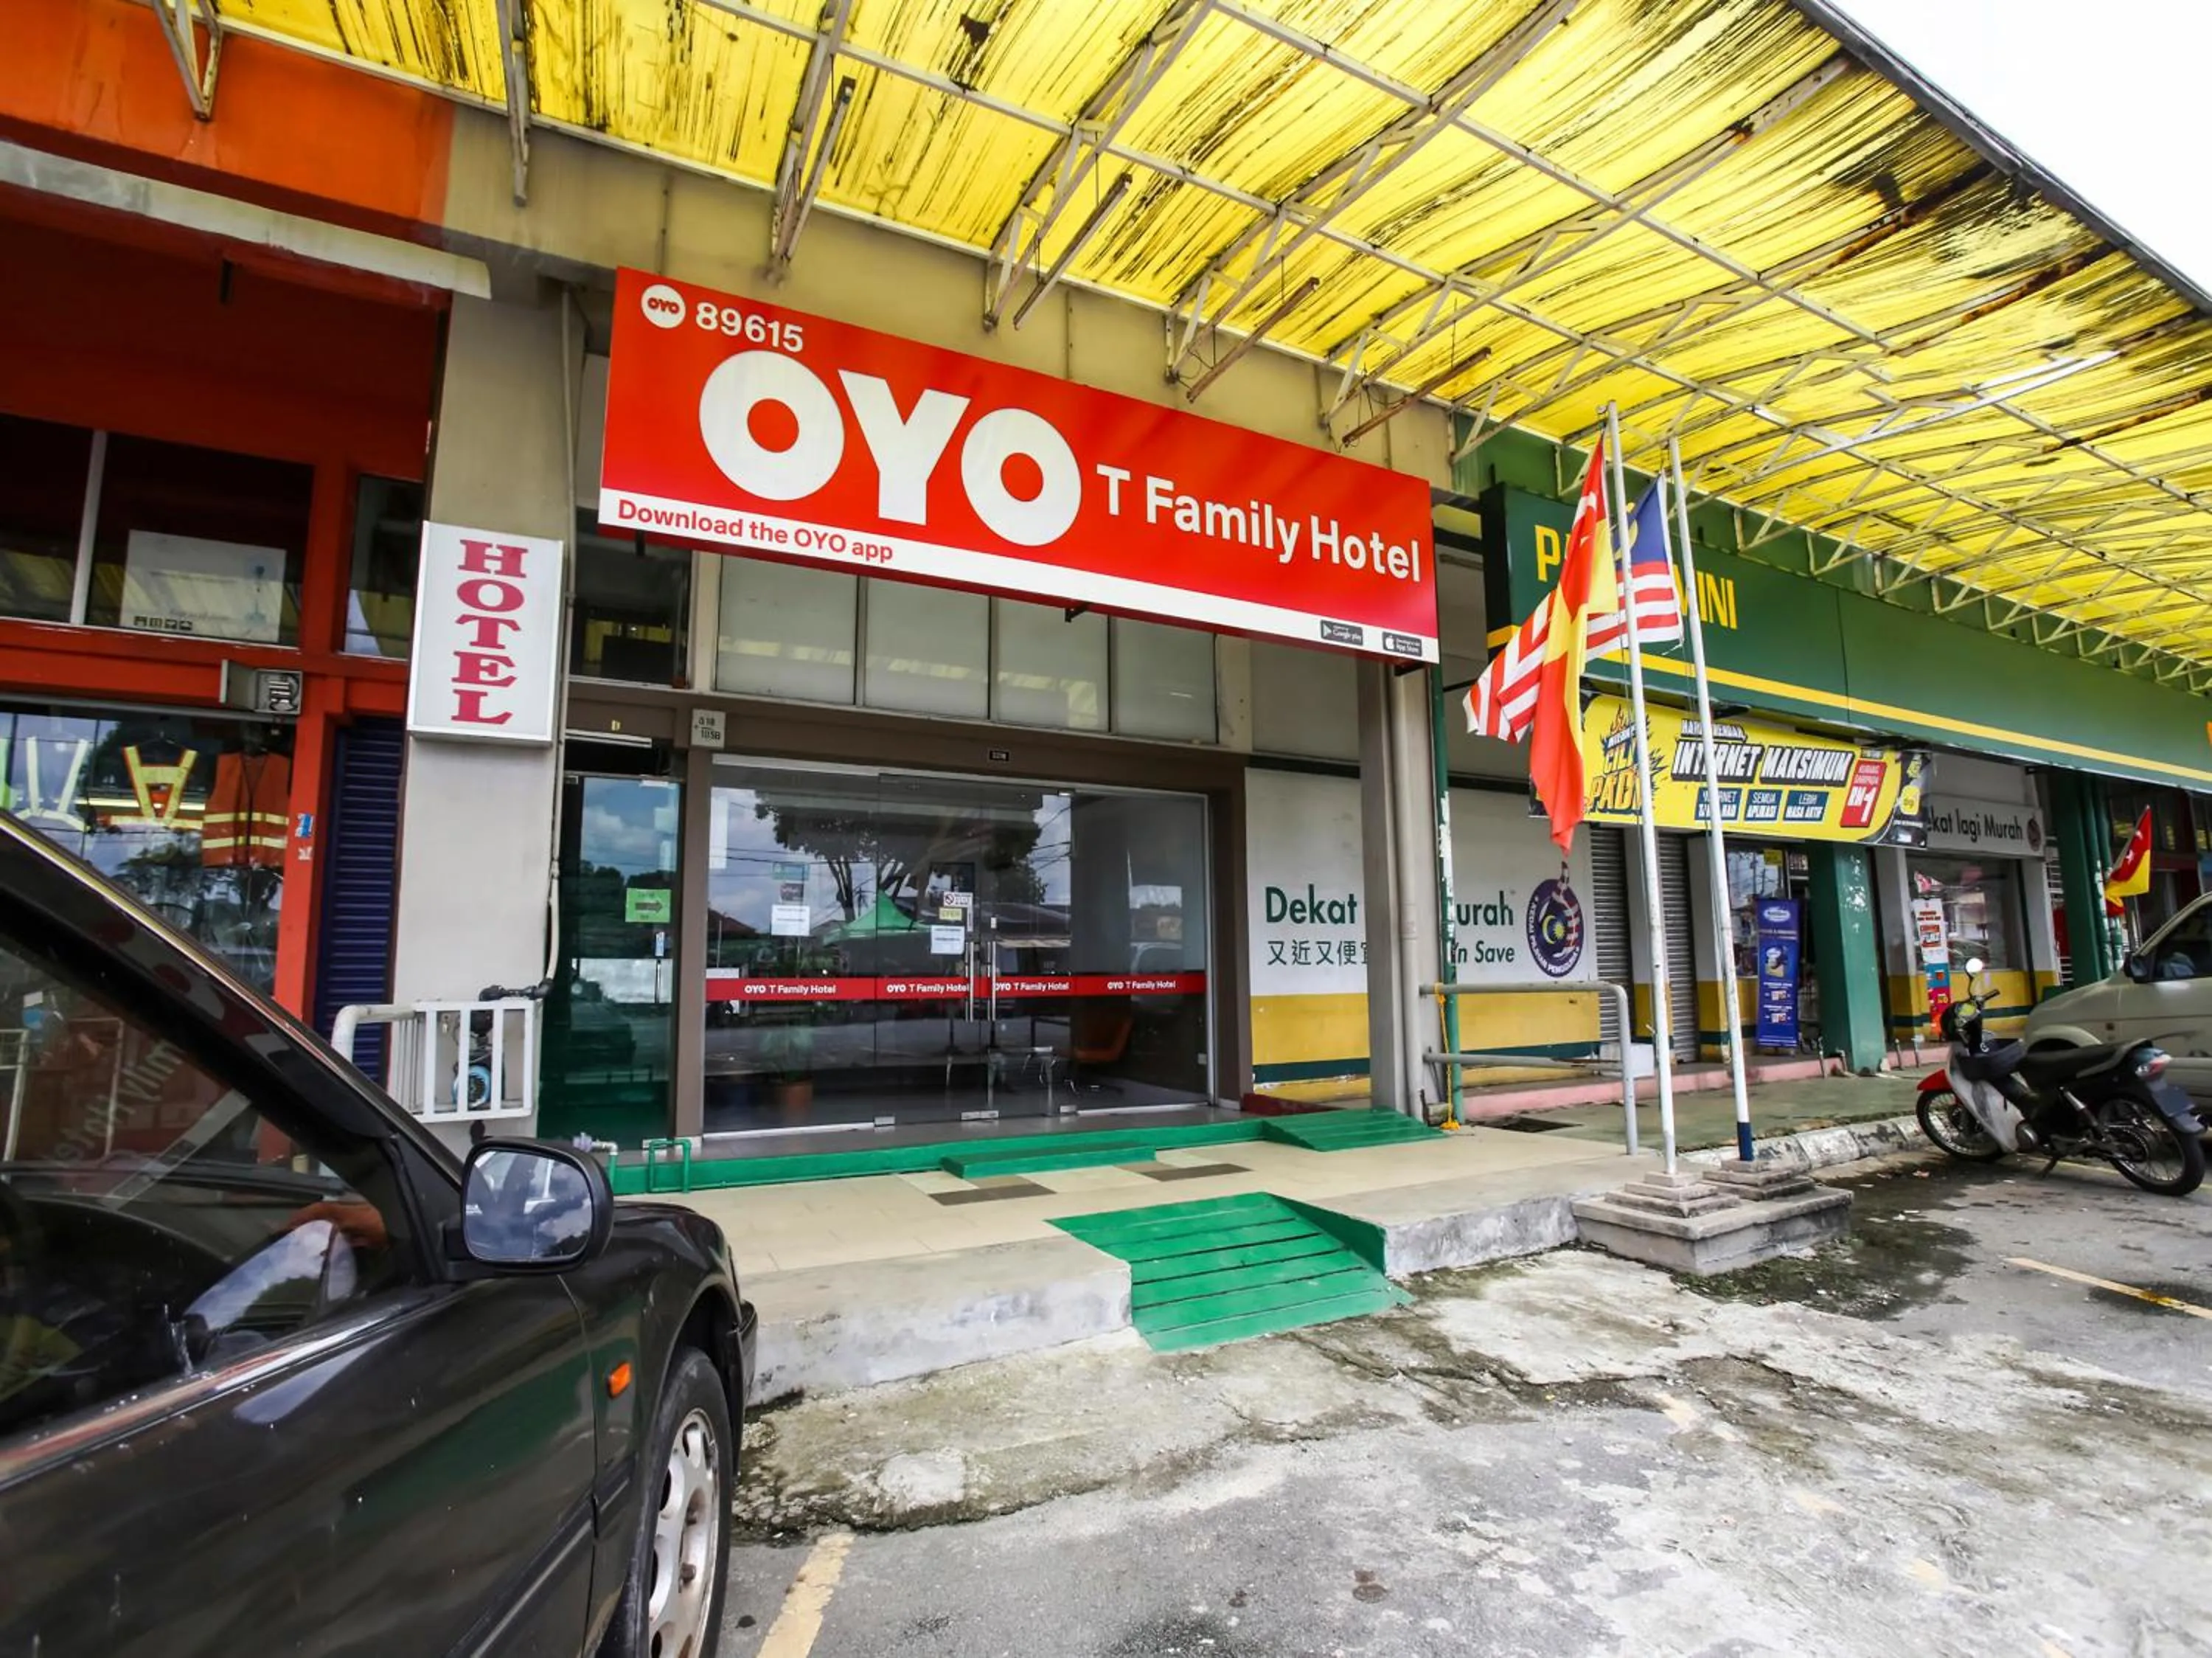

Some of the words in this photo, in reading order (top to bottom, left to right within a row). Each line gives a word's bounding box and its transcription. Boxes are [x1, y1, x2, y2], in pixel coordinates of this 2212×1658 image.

[696, 302, 803, 353] 89615
[699, 350, 1082, 547] OYO
[1096, 464, 1131, 516] T
[1146, 476, 1301, 563] Family
[1310, 515, 1420, 582] Hotel
[617, 499, 745, 538] Download
[749, 521, 788, 544] the
[794, 529, 846, 553] OYO
[852, 541, 893, 563] app
[451, 539, 528, 726] HOTEL
[1673, 741, 1761, 777] INTRNET
[1761, 746, 1853, 782] MAKSIMUM
[1955, 808, 1981, 842] lagi
[1983, 814, 2023, 839] Murah
[1265, 884, 1357, 925] Dekat
[1456, 890, 1514, 926] urah
[1475, 940, 1515, 963] Save
[744, 985, 766, 993] OYO
[769, 985, 776, 993] T
[778, 985, 809, 995] Family
[810, 984, 836, 993] Hotel
[909, 984, 915, 993] T
[917, 983, 945, 994] Family
[1014, 982, 1019, 991] T
[1020, 982, 1046, 992] Family
[1048, 981, 1069, 991] Hotel
[1132, 981, 1155, 991] Family
[1156, 980, 1176, 989] Hotel
